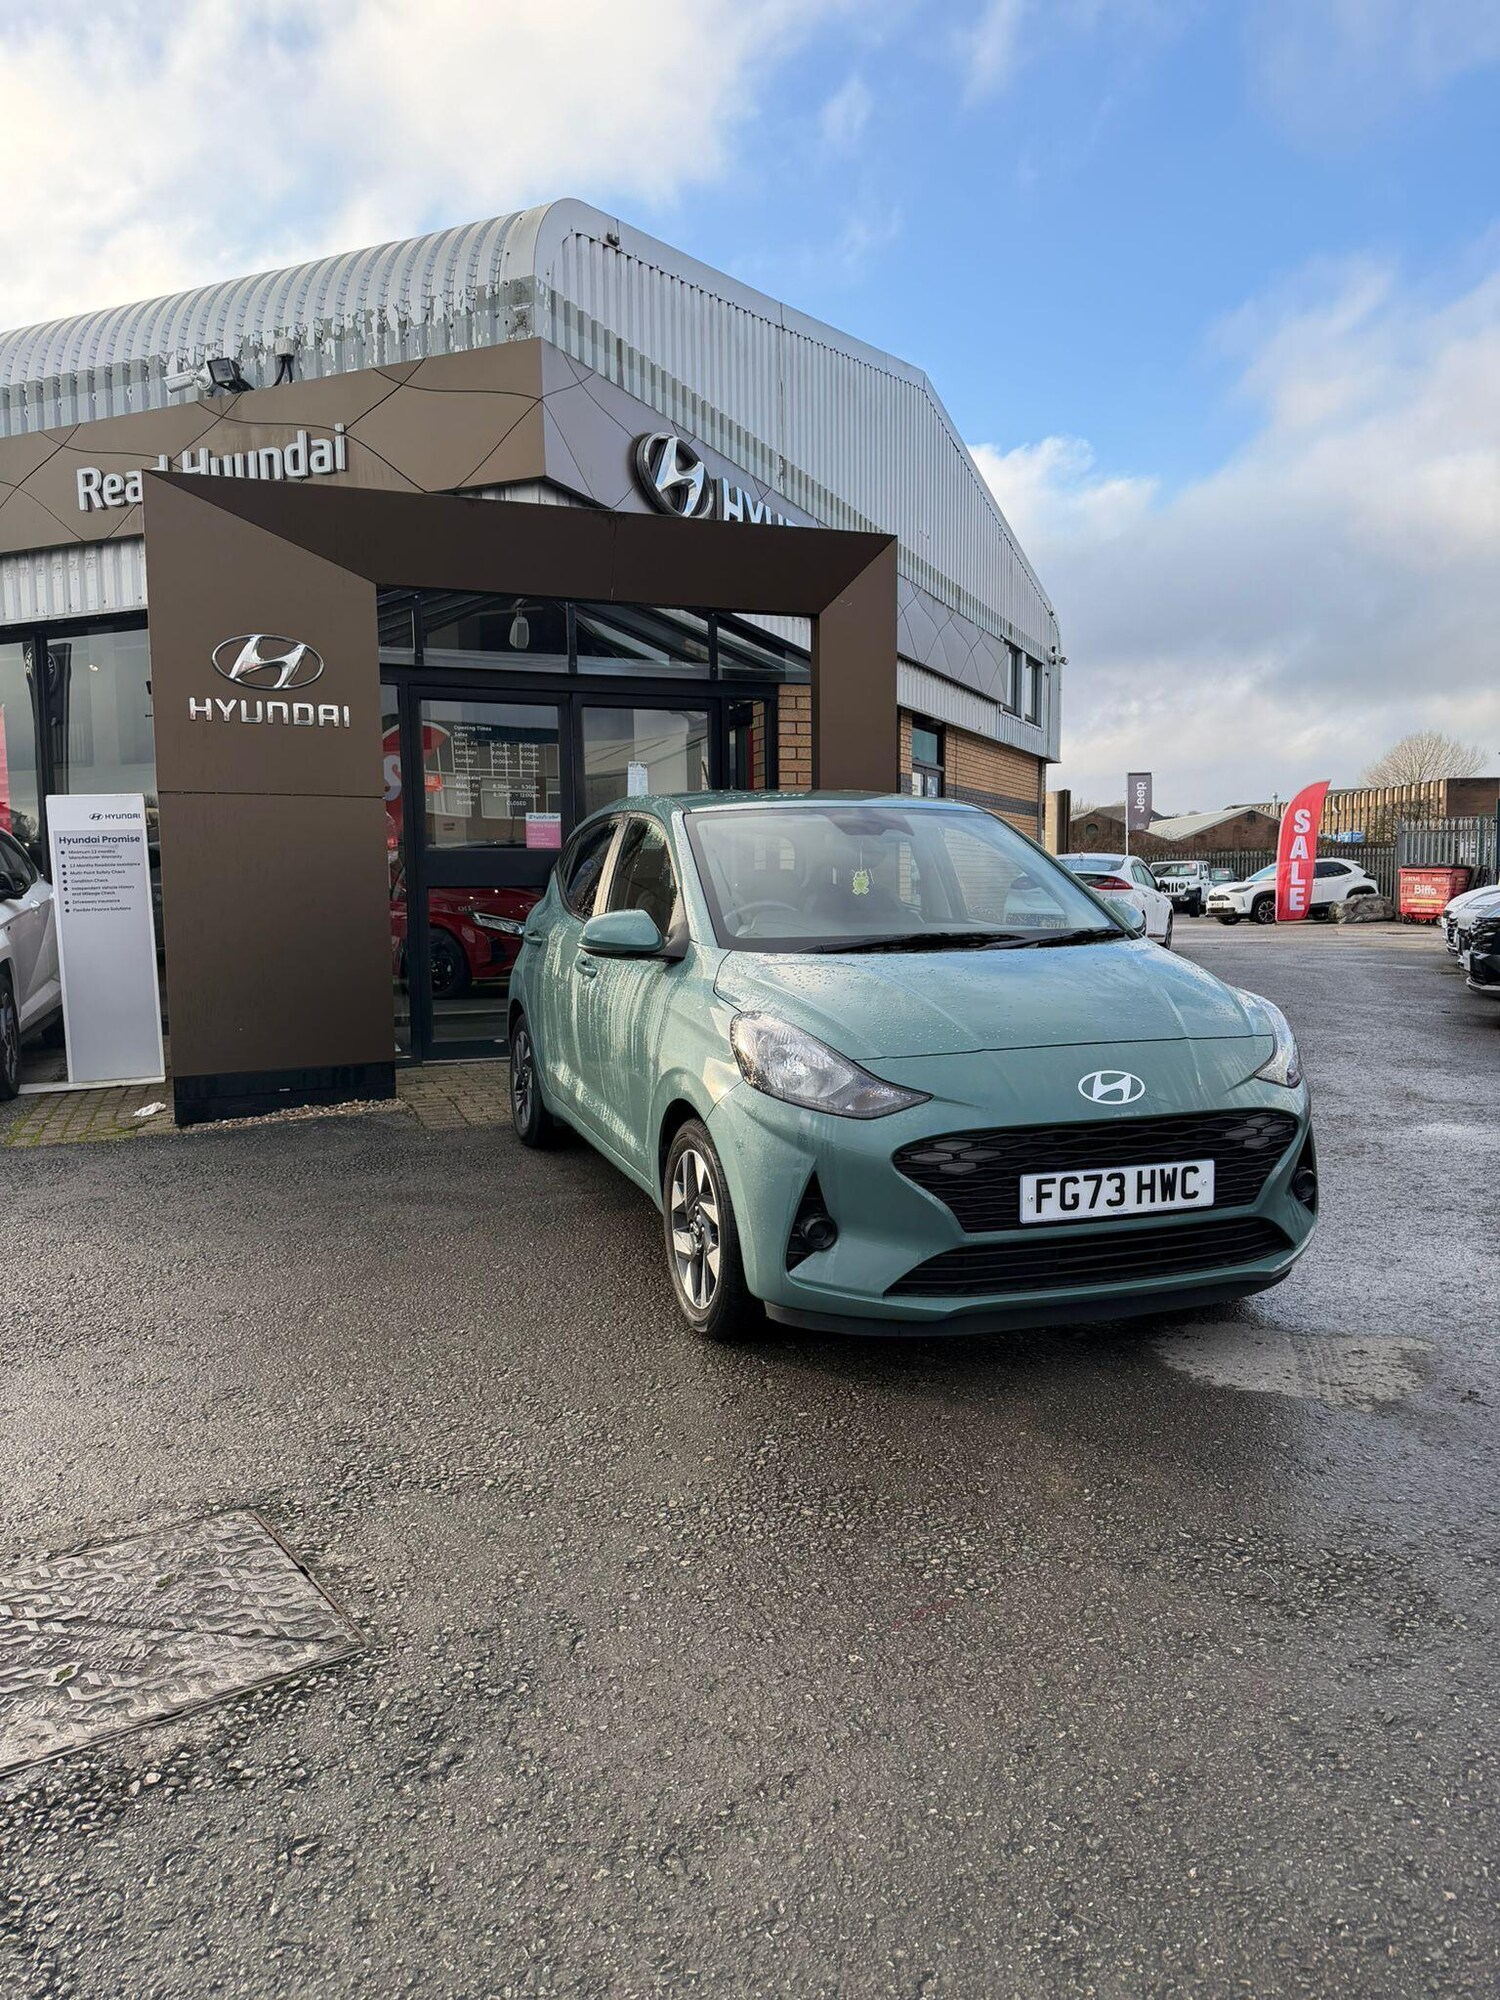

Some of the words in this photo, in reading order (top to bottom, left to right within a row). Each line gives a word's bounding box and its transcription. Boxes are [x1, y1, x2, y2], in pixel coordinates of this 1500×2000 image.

[189, 697, 350, 728] HYUNDAI
[1134, 782, 1147, 813] Jeep
[59, 836, 100, 845] Hyundai
[102, 835, 140, 843] Promise
[1290, 808, 1311, 911] SALE
[1036, 1171, 1126, 1214] FG73
[1136, 1166, 1200, 1204] HWC
[30, 1637, 156, 1658] SPARTAN
[89, 1659, 147, 1673] GRADE
[0, 1696, 60, 1716] TON
[60, 1703, 117, 1721] PLC
